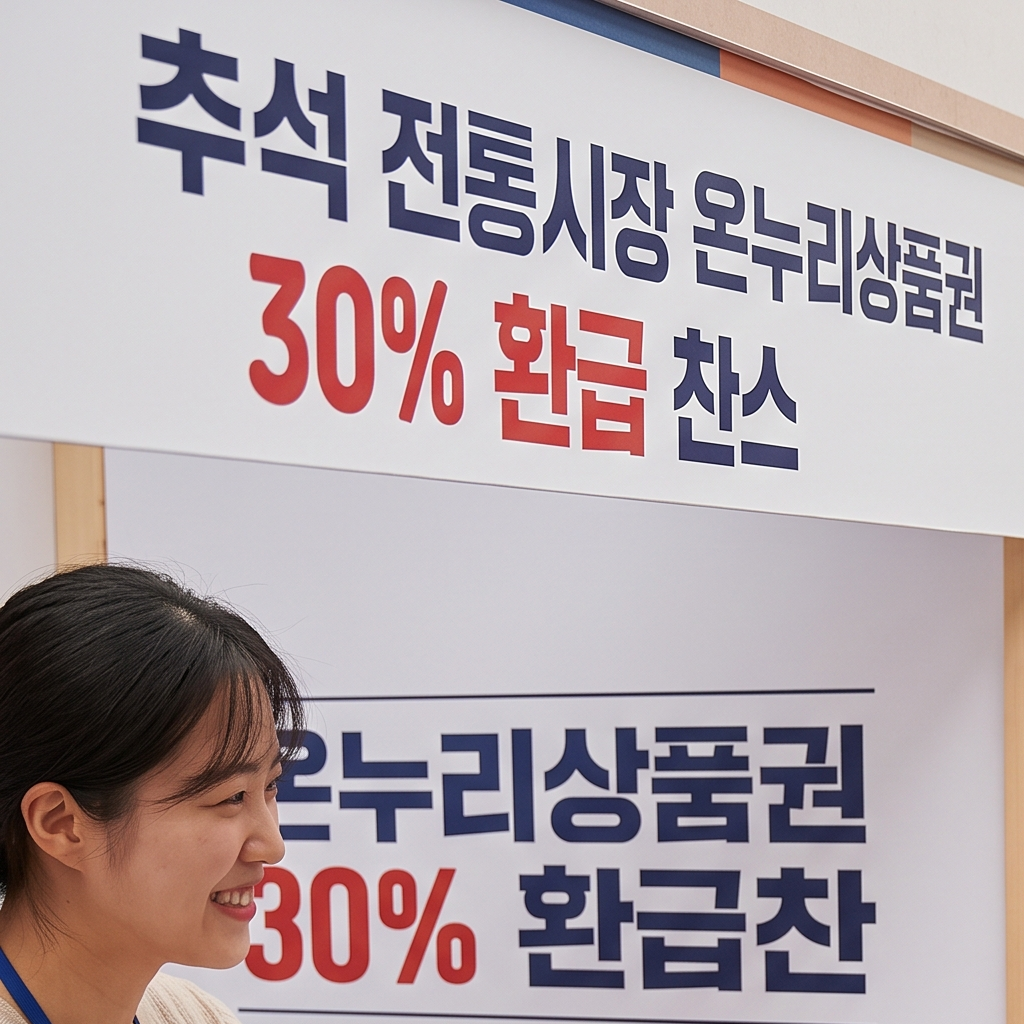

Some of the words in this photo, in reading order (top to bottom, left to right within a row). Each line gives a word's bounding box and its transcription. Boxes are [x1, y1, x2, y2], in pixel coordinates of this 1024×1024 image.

[137, 28, 347, 222] 추석
[381, 89, 673, 284] 전통시장
[691, 170, 983, 344] 온누리상품권
[248, 252, 464, 426] 30%
[493, 292, 648, 457] 환급
[673, 326, 799, 471] 찬스
[277, 724, 866, 844] 온누리상품권
[245, 866, 477, 985] 30%
[518, 865, 877, 995] 환급찬
